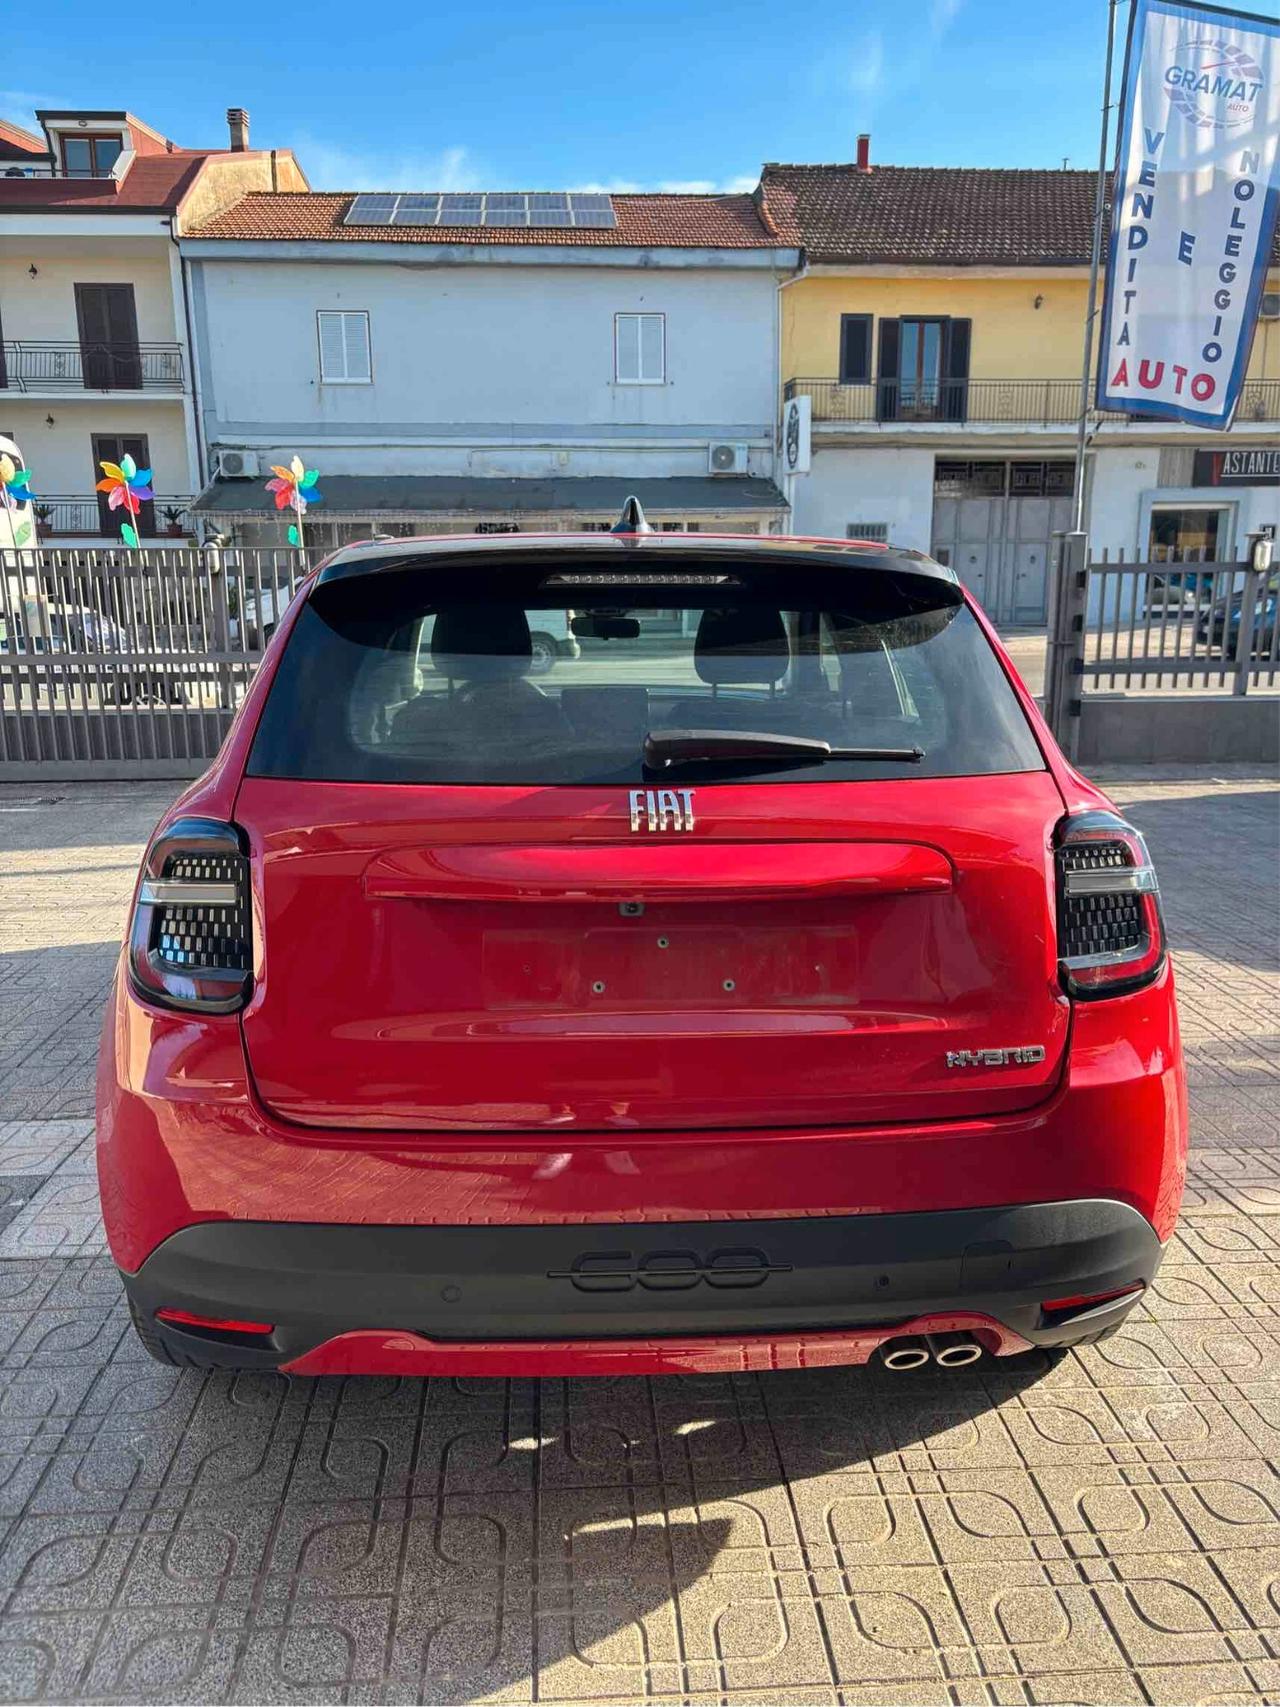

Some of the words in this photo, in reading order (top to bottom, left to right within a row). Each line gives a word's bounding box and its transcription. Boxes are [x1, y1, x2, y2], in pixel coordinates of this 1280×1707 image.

[1165, 65, 1263, 102] GRAMAT
[1227, 103, 1249, 113] AUTO
[1117, 127, 1165, 346] VENDITA
[1178, 231, 1196, 266] E
[1202, 150, 1260, 363] NOLEGGIO
[1111, 358, 1216, 402] AUTO
[629, 789, 696, 831] FIAT
[946, 1045, 1045, 1068] HYBRID
[570, 1247, 772, 1293] 600
